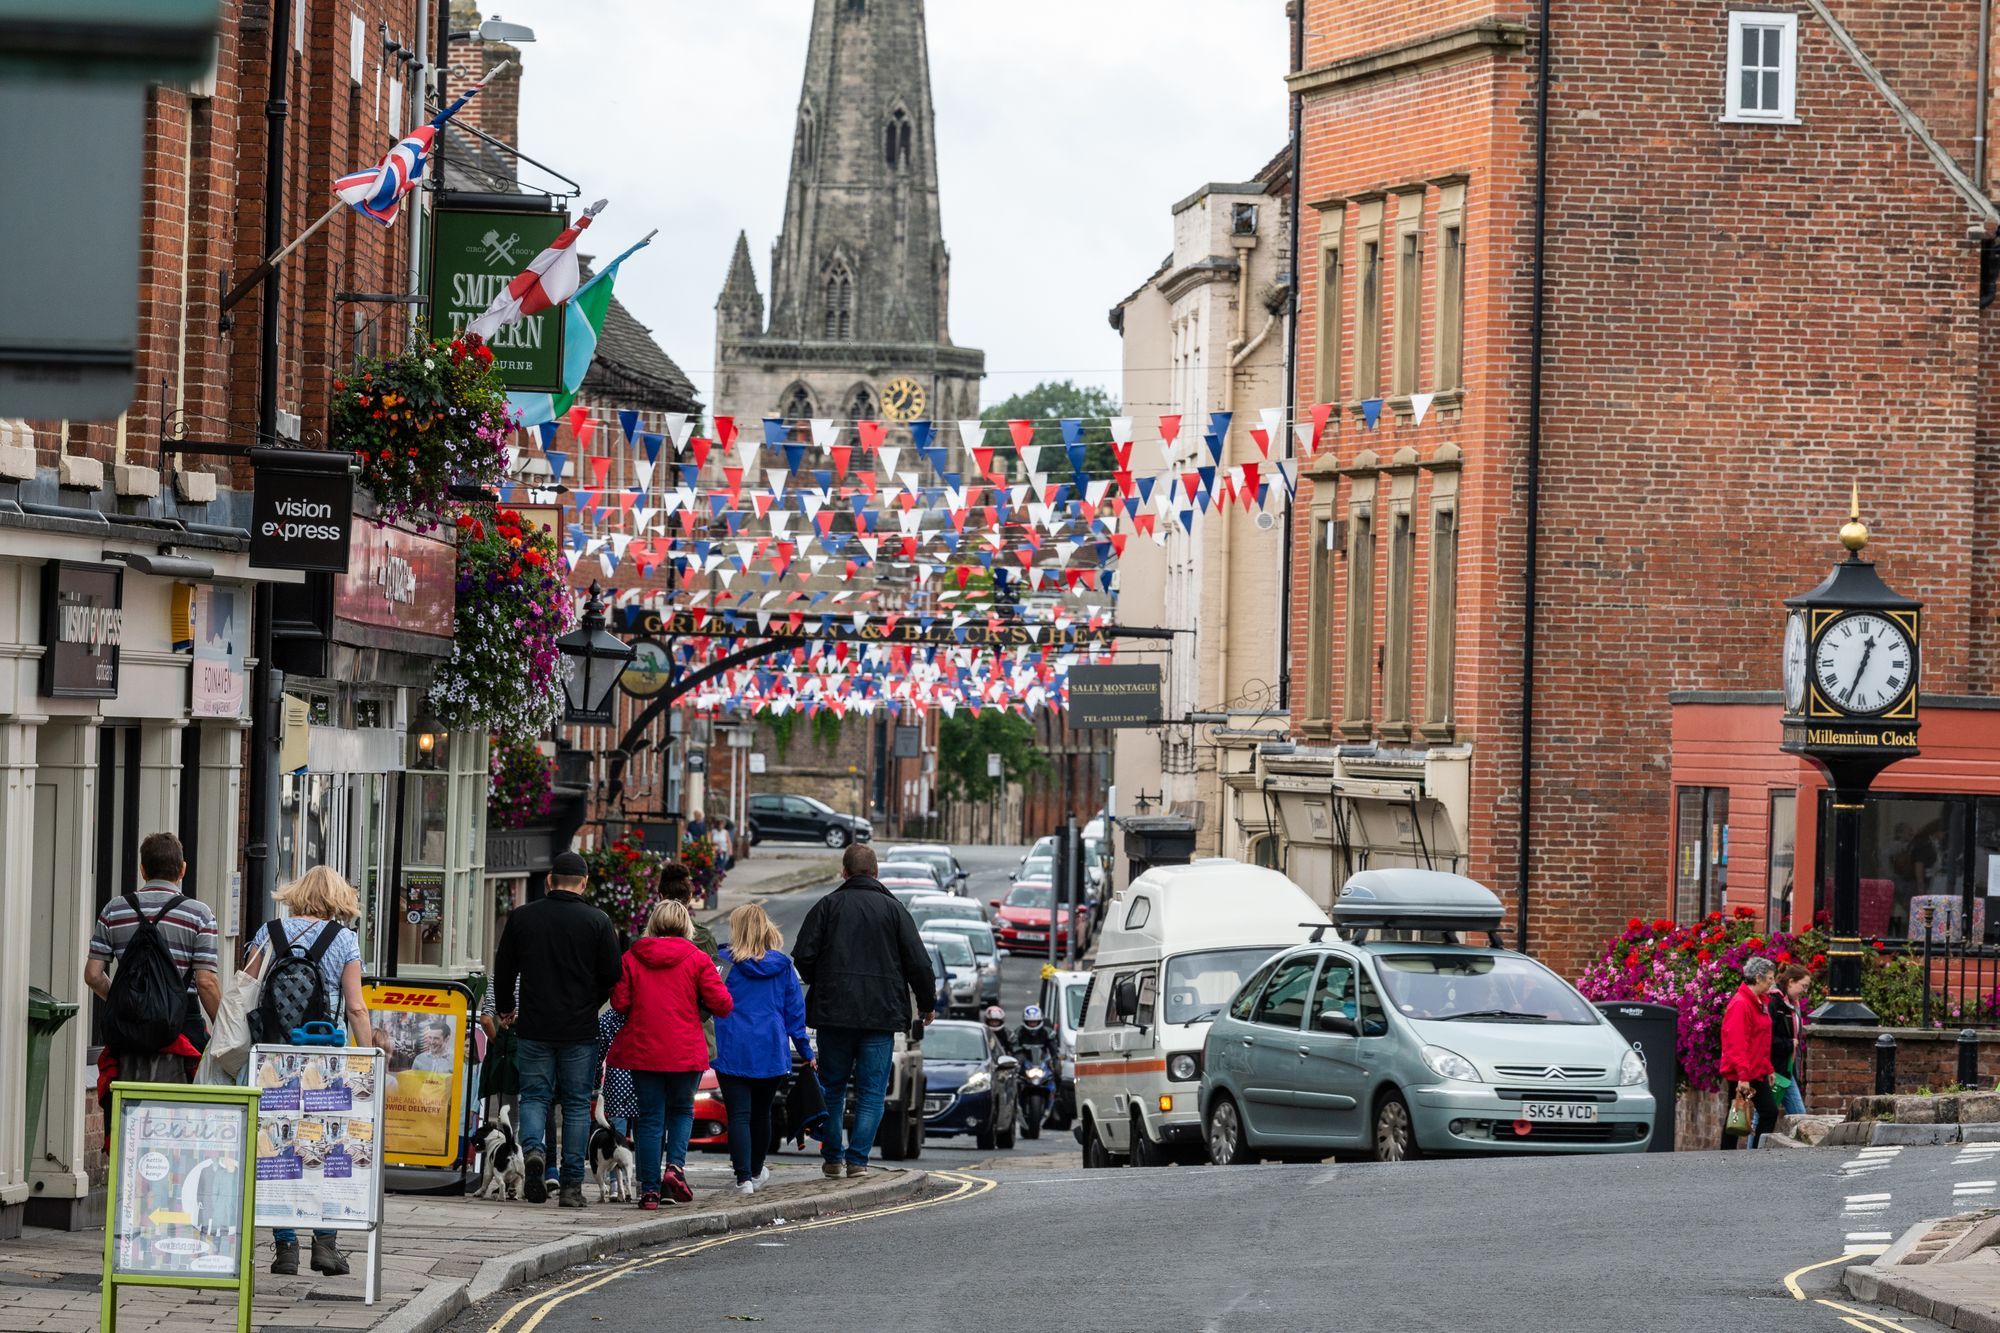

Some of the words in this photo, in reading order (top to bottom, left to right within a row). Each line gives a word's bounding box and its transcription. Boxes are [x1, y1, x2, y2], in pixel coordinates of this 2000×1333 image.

[452, 272, 516, 308] SMIT
[491, 360, 533, 370] OURNE
[275, 498, 331, 518] vision
[262, 519, 341, 541] express
[861, 622, 881, 639] &
[205, 667, 231, 694] FOINAVEN
[1072, 684, 1101, 692] SALLY
[1103, 683, 1158, 692] MONTAGUE
[1807, 729, 1878, 745] Millennium
[1881, 731, 1917, 746] Clock
[383, 992, 441, 1007] DHL
[387, 1096, 402, 1104] CURE
[409, 1105, 441, 1114] DELIVERY
[1529, 1105, 1563, 1118] SK54
[1568, 1106, 1592, 1119] VCD
